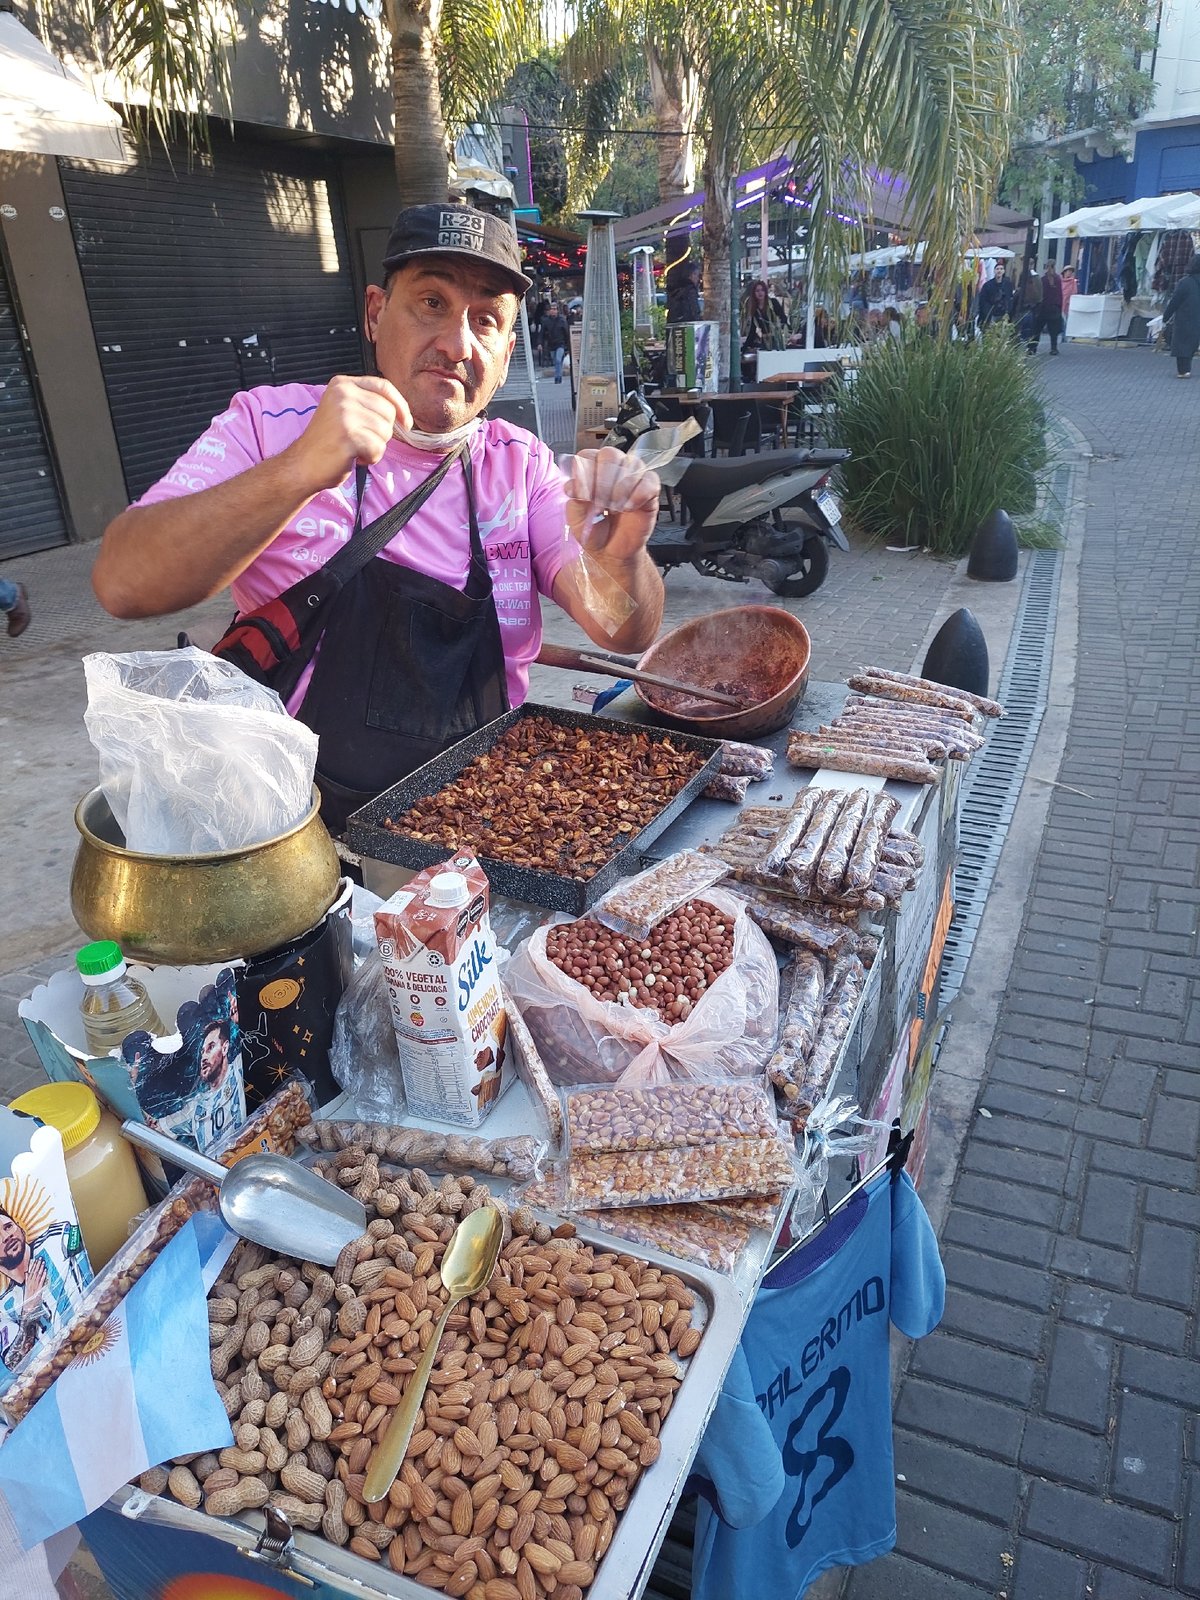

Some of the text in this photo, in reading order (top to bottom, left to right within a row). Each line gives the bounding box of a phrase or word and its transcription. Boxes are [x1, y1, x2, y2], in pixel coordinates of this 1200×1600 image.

[442, 213, 481, 230] R-28
[438, 231, 484, 251] CREW
[295, 517, 349, 542] eni
[485, 541, 529, 561] BWT
[499, 582, 513, 592] ONE
[405, 971, 448, 984] VEGETAL
[458, 939, 494, 1012] Silk
[412, 983, 448, 993] DELICIOSA
[210, 1106, 225, 1136] 10
[755, 1275, 885, 1420] PALERMO
